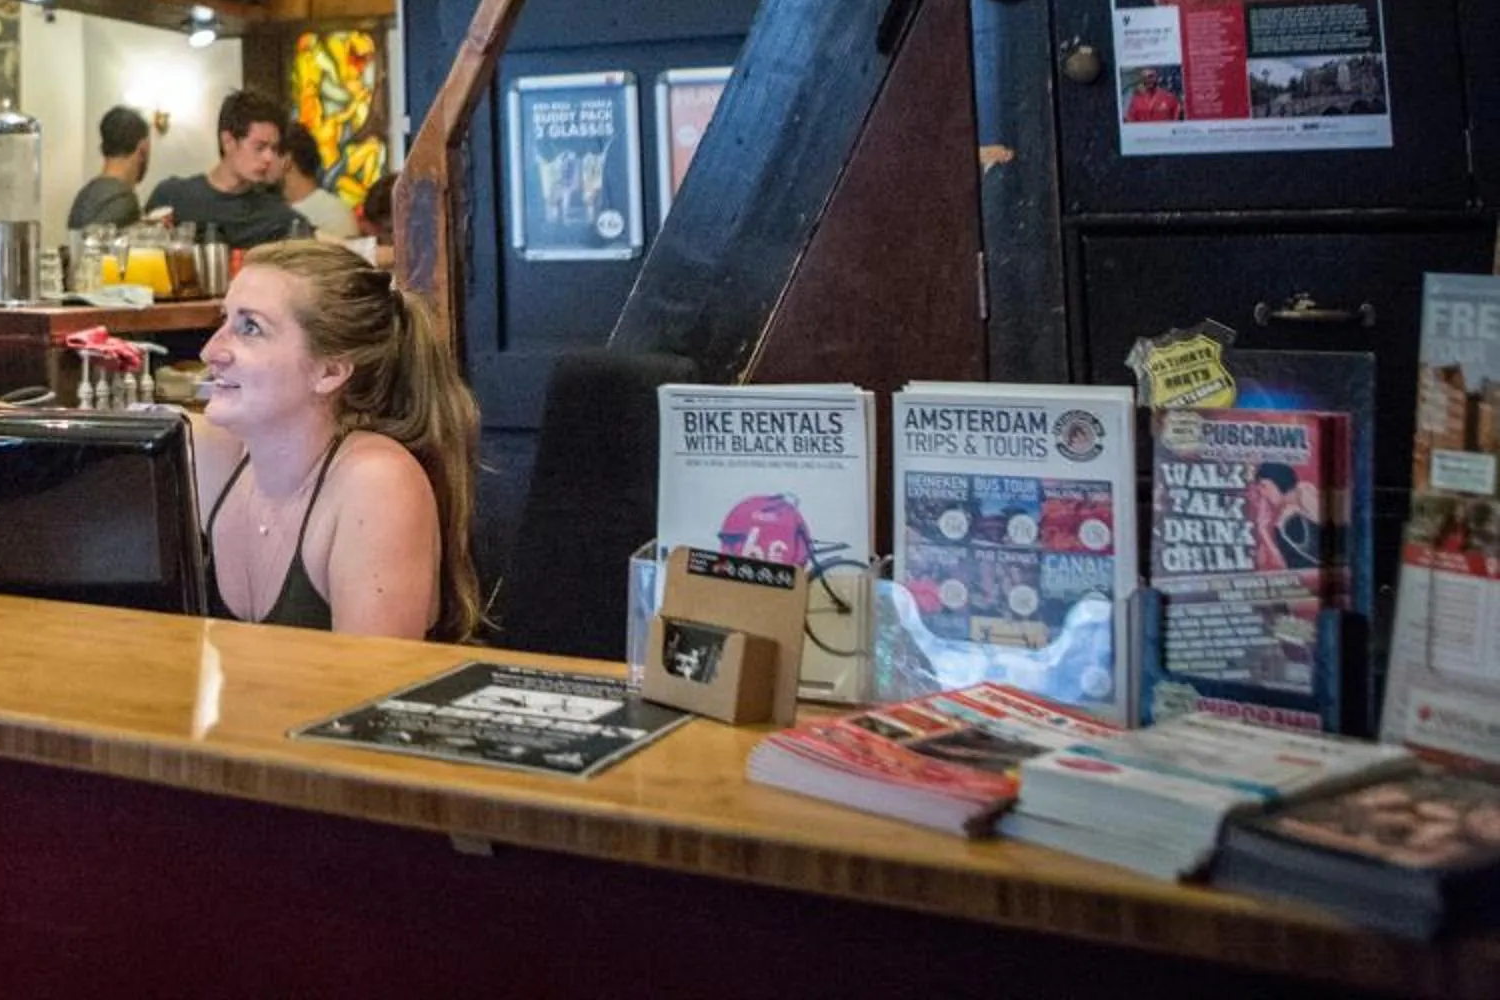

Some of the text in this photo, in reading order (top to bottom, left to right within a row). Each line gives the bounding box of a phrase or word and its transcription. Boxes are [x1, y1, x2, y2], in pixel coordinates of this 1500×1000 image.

[683, 411, 844, 435] BIKE RENTALS
[904, 408, 1048, 434] AMSTERDAM
[685, 435, 845, 454] WITH BLACK BIKES
[904, 432, 958, 454] TRIPS
[963, 435, 977, 455] &
[983, 435, 1048, 458] TOURS
[1161, 463, 1246, 489] WALK
[1168, 488, 1246, 519] TALK
[1163, 518, 1257, 546] DRINK
